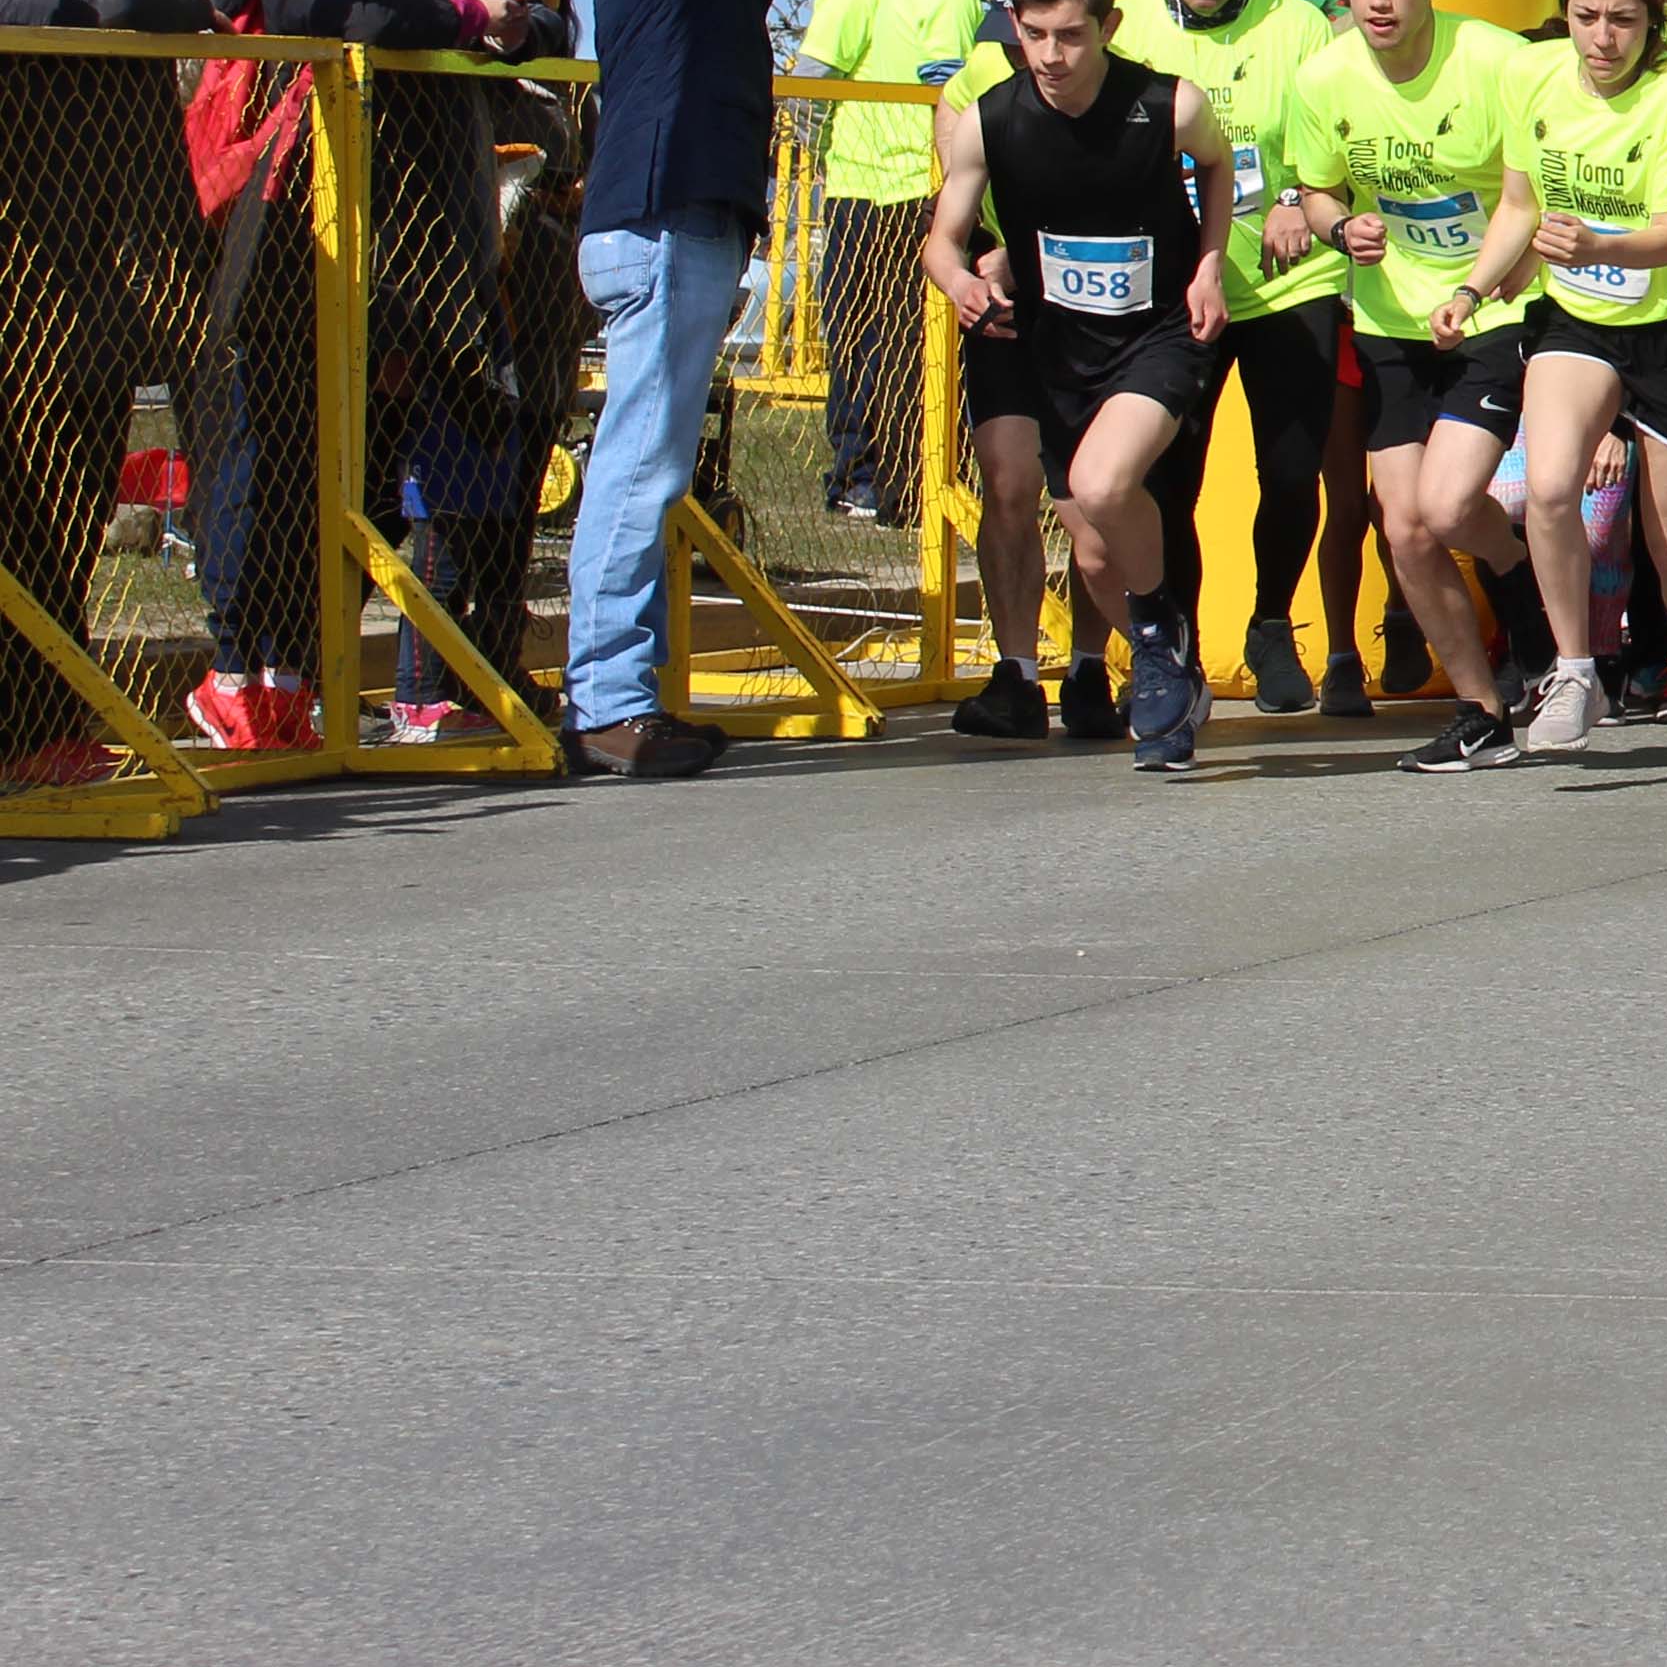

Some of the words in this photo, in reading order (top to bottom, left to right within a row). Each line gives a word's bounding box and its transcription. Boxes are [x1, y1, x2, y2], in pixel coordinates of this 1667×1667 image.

[1207, 87, 1232, 104] ma
[1385, 136, 1433, 161] Toma
[1540, 148, 1574, 210] CORRIDA
[1574, 153, 1624, 187] Toma
[1406, 223, 1470, 249] 015
[1062, 268, 1131, 299] 058
